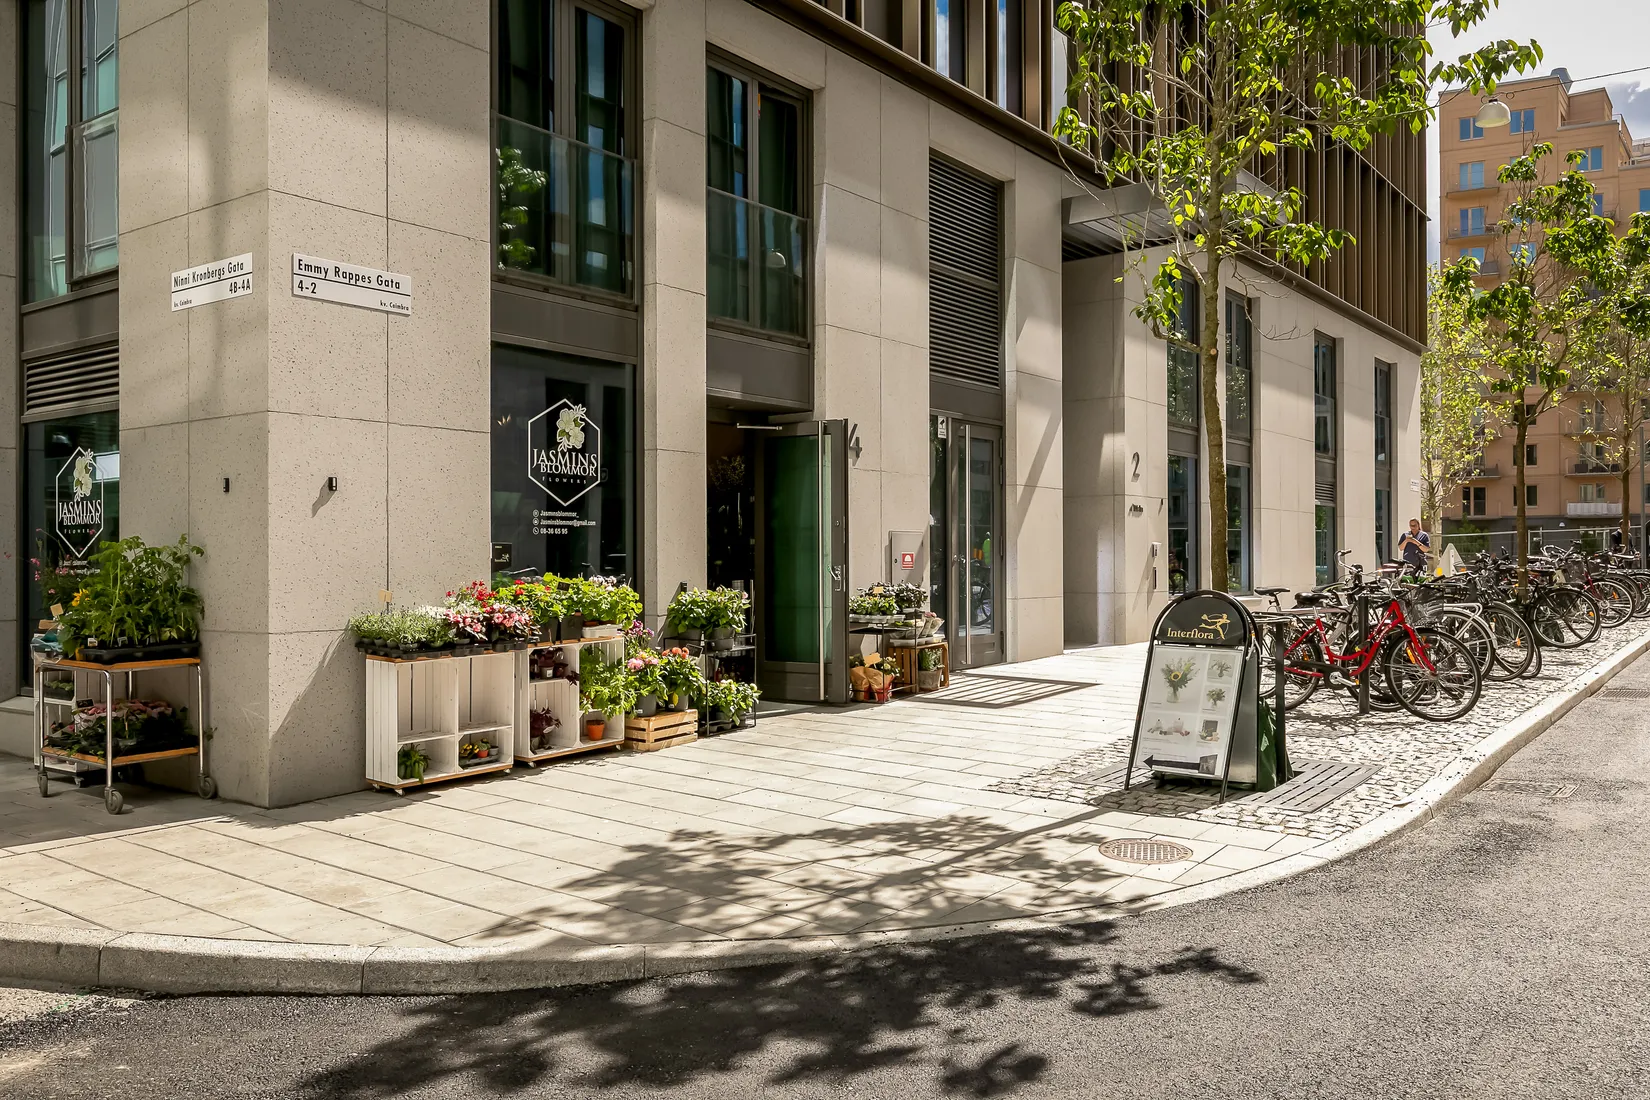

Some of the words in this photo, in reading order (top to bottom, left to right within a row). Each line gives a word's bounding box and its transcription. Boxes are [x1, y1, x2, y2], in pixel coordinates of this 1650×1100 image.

[173, 273, 190, 288] Ninni
[192, 266, 225, 283] Kronbergs
[227, 261, 244, 274] Gata
[298, 258, 329, 279] Emmy
[334, 265, 372, 285] Rappes
[376, 274, 401, 290] Gata
[228, 278, 251, 294] 4B-4A
[297, 279, 317, 295] 4-2
[389, 301, 410, 312] Coimbra
[848, 423, 863, 459] 4
[532, 448, 598, 470] JASMINS
[1131, 451, 1141, 478] 2
[540, 461, 597, 477] BLOMMOR
[58, 499, 102, 522] JASMINS
[63, 511, 101, 526] BLOMMOR
[1167, 627, 1214, 640] Interflora
